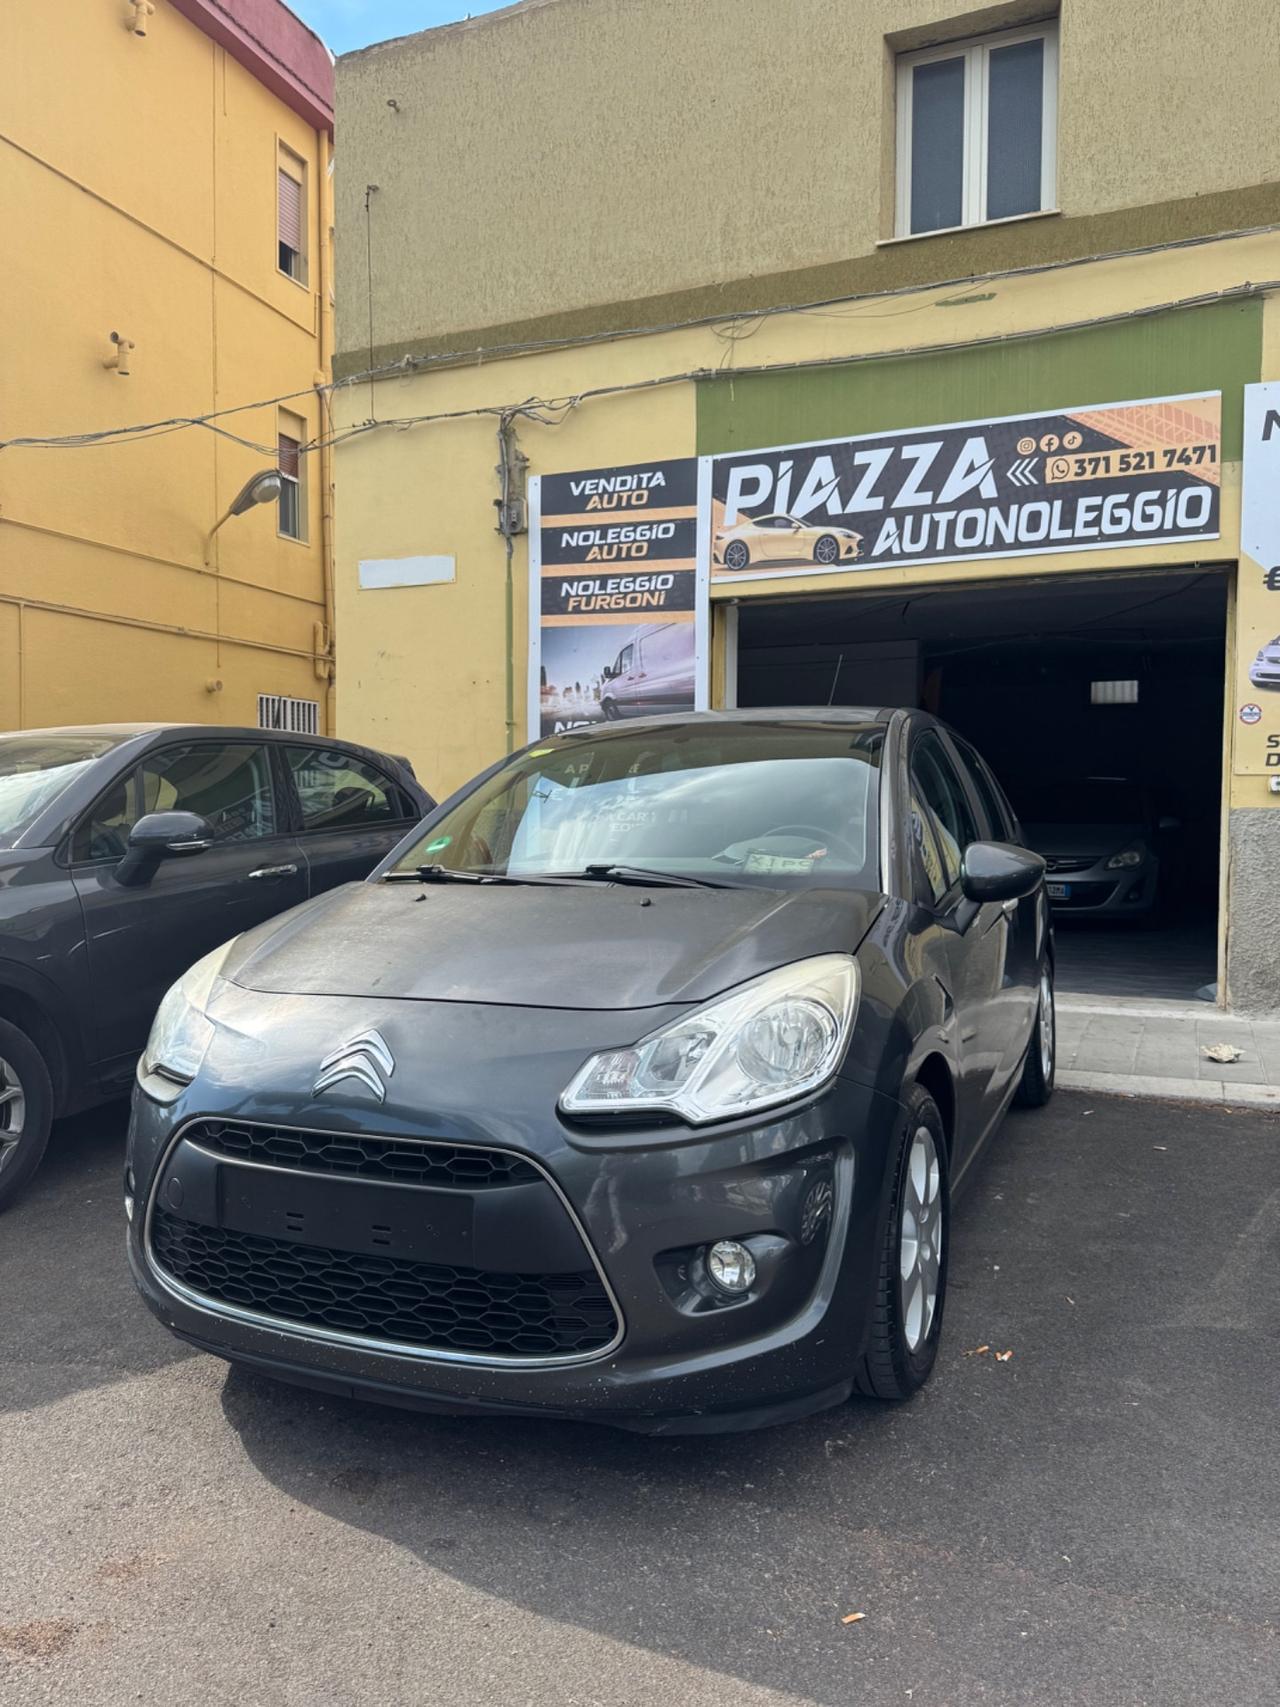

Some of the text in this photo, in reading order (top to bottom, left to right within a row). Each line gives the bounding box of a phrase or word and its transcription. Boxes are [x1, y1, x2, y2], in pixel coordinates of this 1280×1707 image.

[1074, 444, 1217, 477] 371 521 7471
[570, 471, 666, 496] VENDITA
[724, 436, 998, 527] PIAZZA
[585, 490, 649, 511] AUTO
[871, 485, 1213, 556] AUTONOLEGGIO
[561, 522, 675, 548] NOLEGGIO
[585, 542, 648, 561] AUTO
[561, 574, 674, 597] NOLEGGIO
[567, 591, 666, 612] FURGONI
